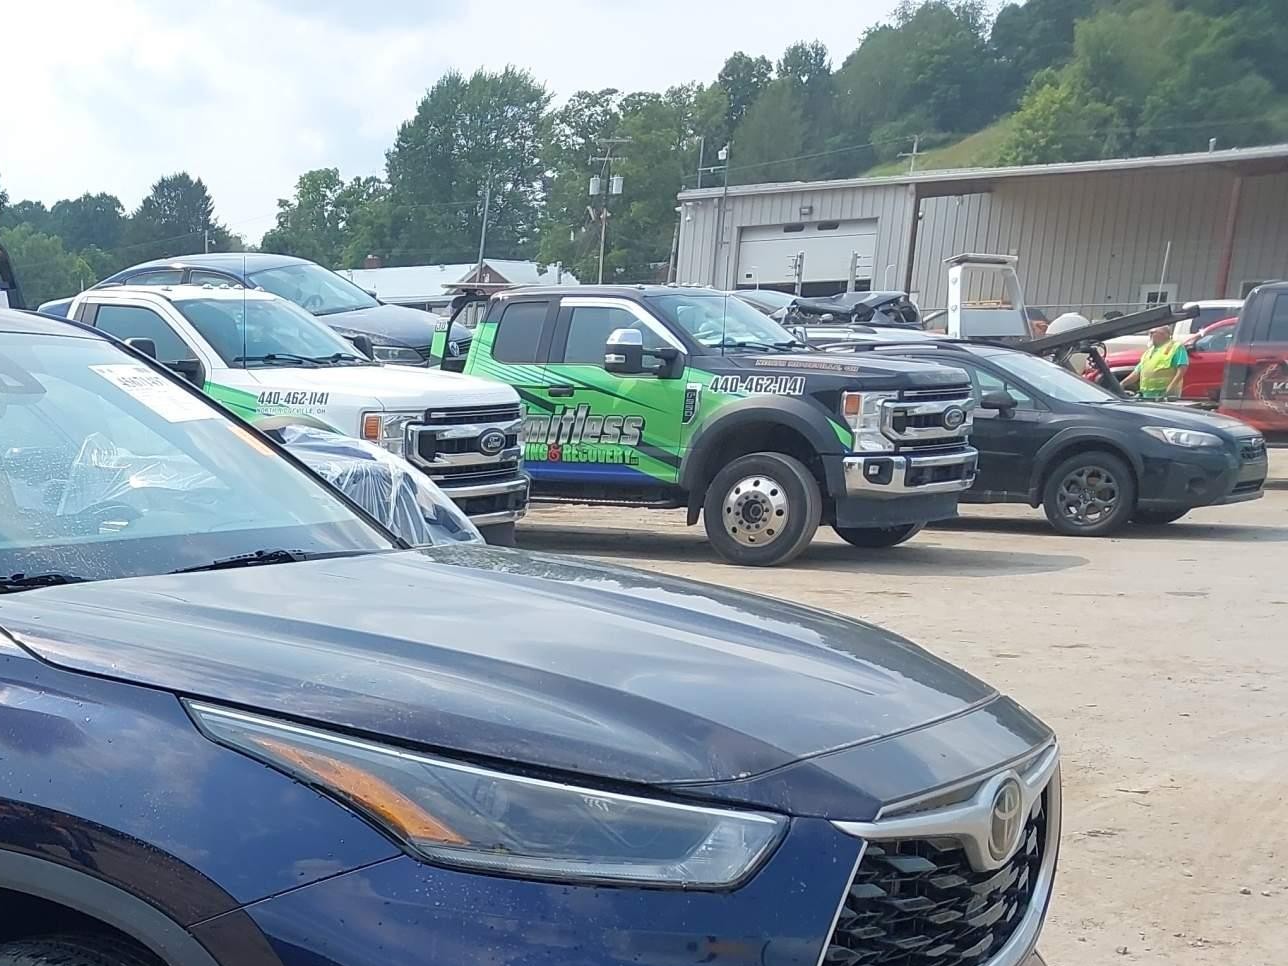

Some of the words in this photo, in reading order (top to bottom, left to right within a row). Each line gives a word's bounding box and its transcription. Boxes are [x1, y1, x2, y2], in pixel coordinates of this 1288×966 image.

[709, 375, 806, 396] 440-462-1141
[257, 391, 330, 405] 440-462-1141
[562, 443, 633, 464] RECOVERY
